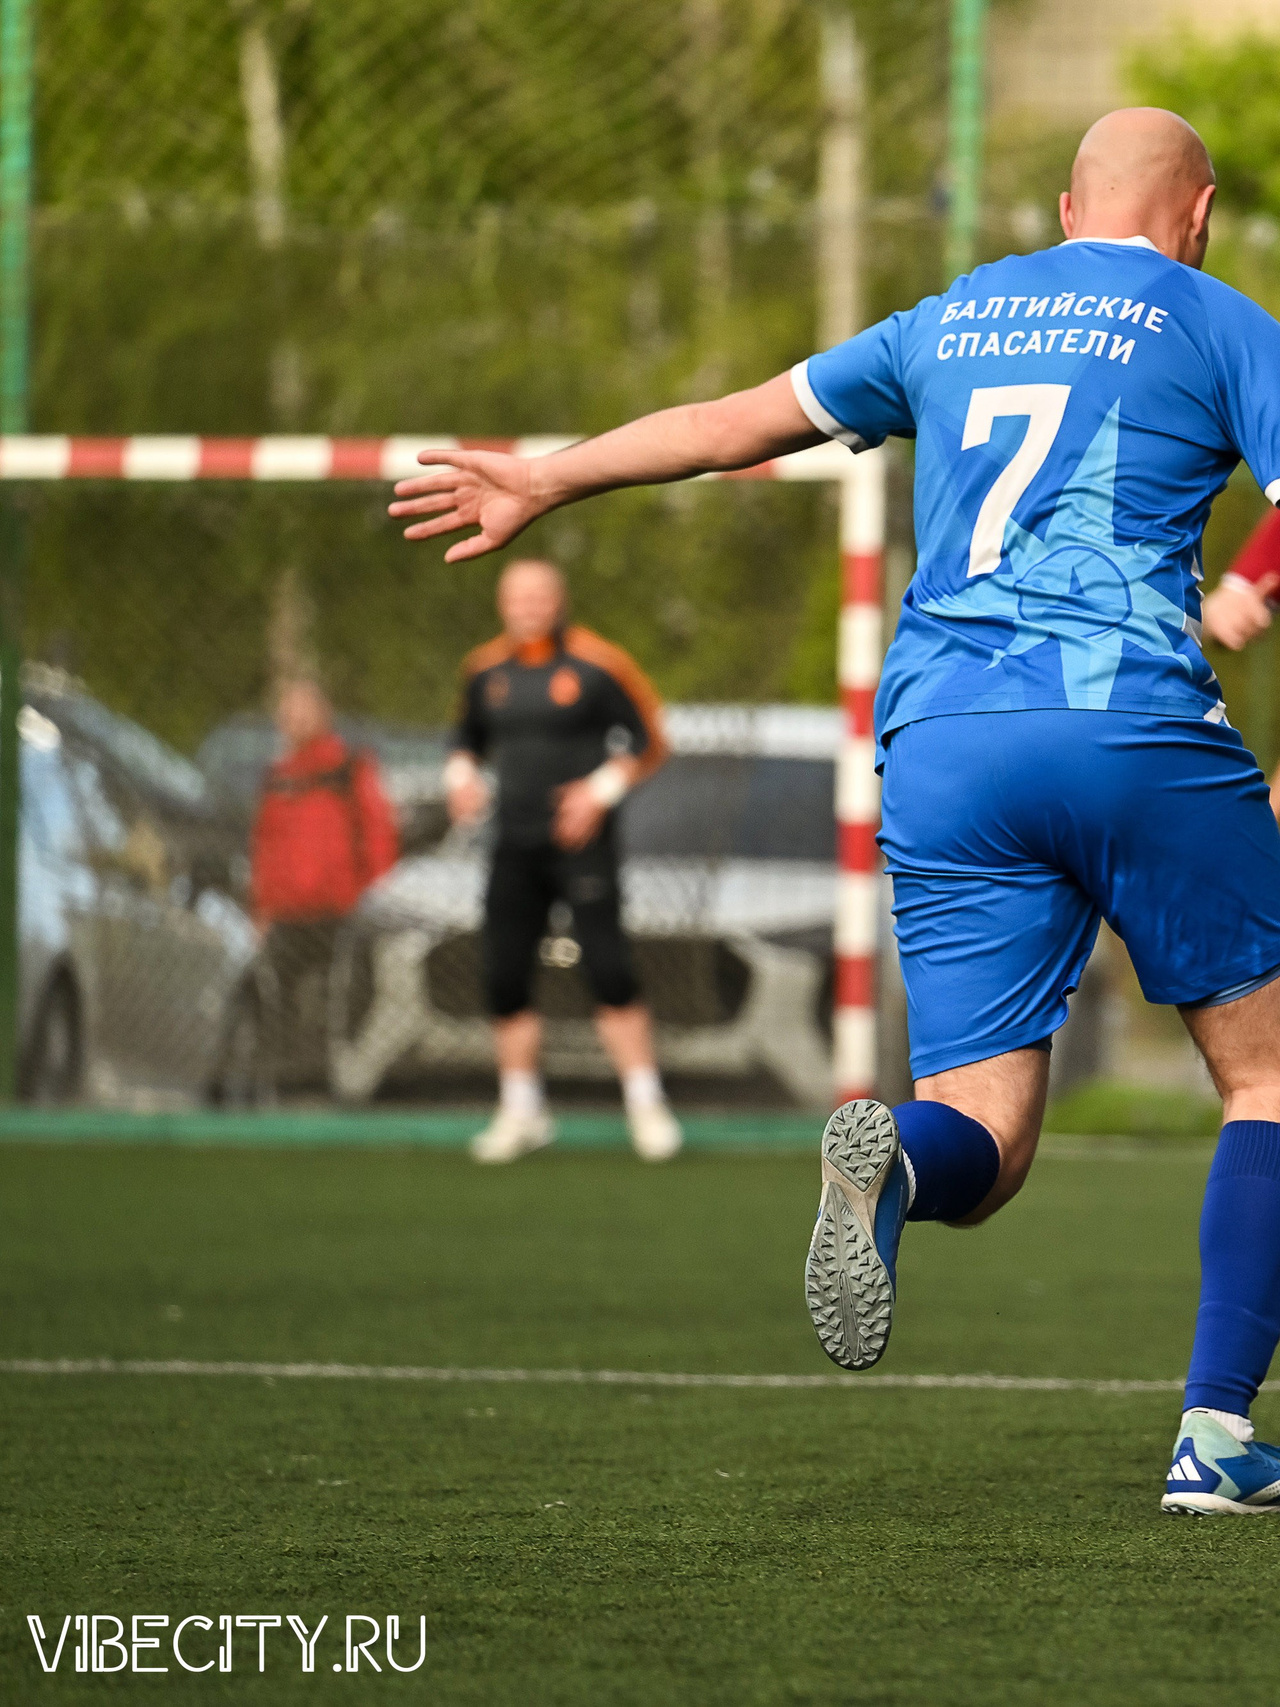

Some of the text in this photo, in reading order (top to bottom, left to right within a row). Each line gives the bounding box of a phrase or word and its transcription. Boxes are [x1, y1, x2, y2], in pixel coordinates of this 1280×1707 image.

[939, 291, 1169, 333] БАЛТИЙСКИЕ
[936, 328, 1137, 365] СПАСАТЕЛИ
[960, 383, 1073, 579] 7
